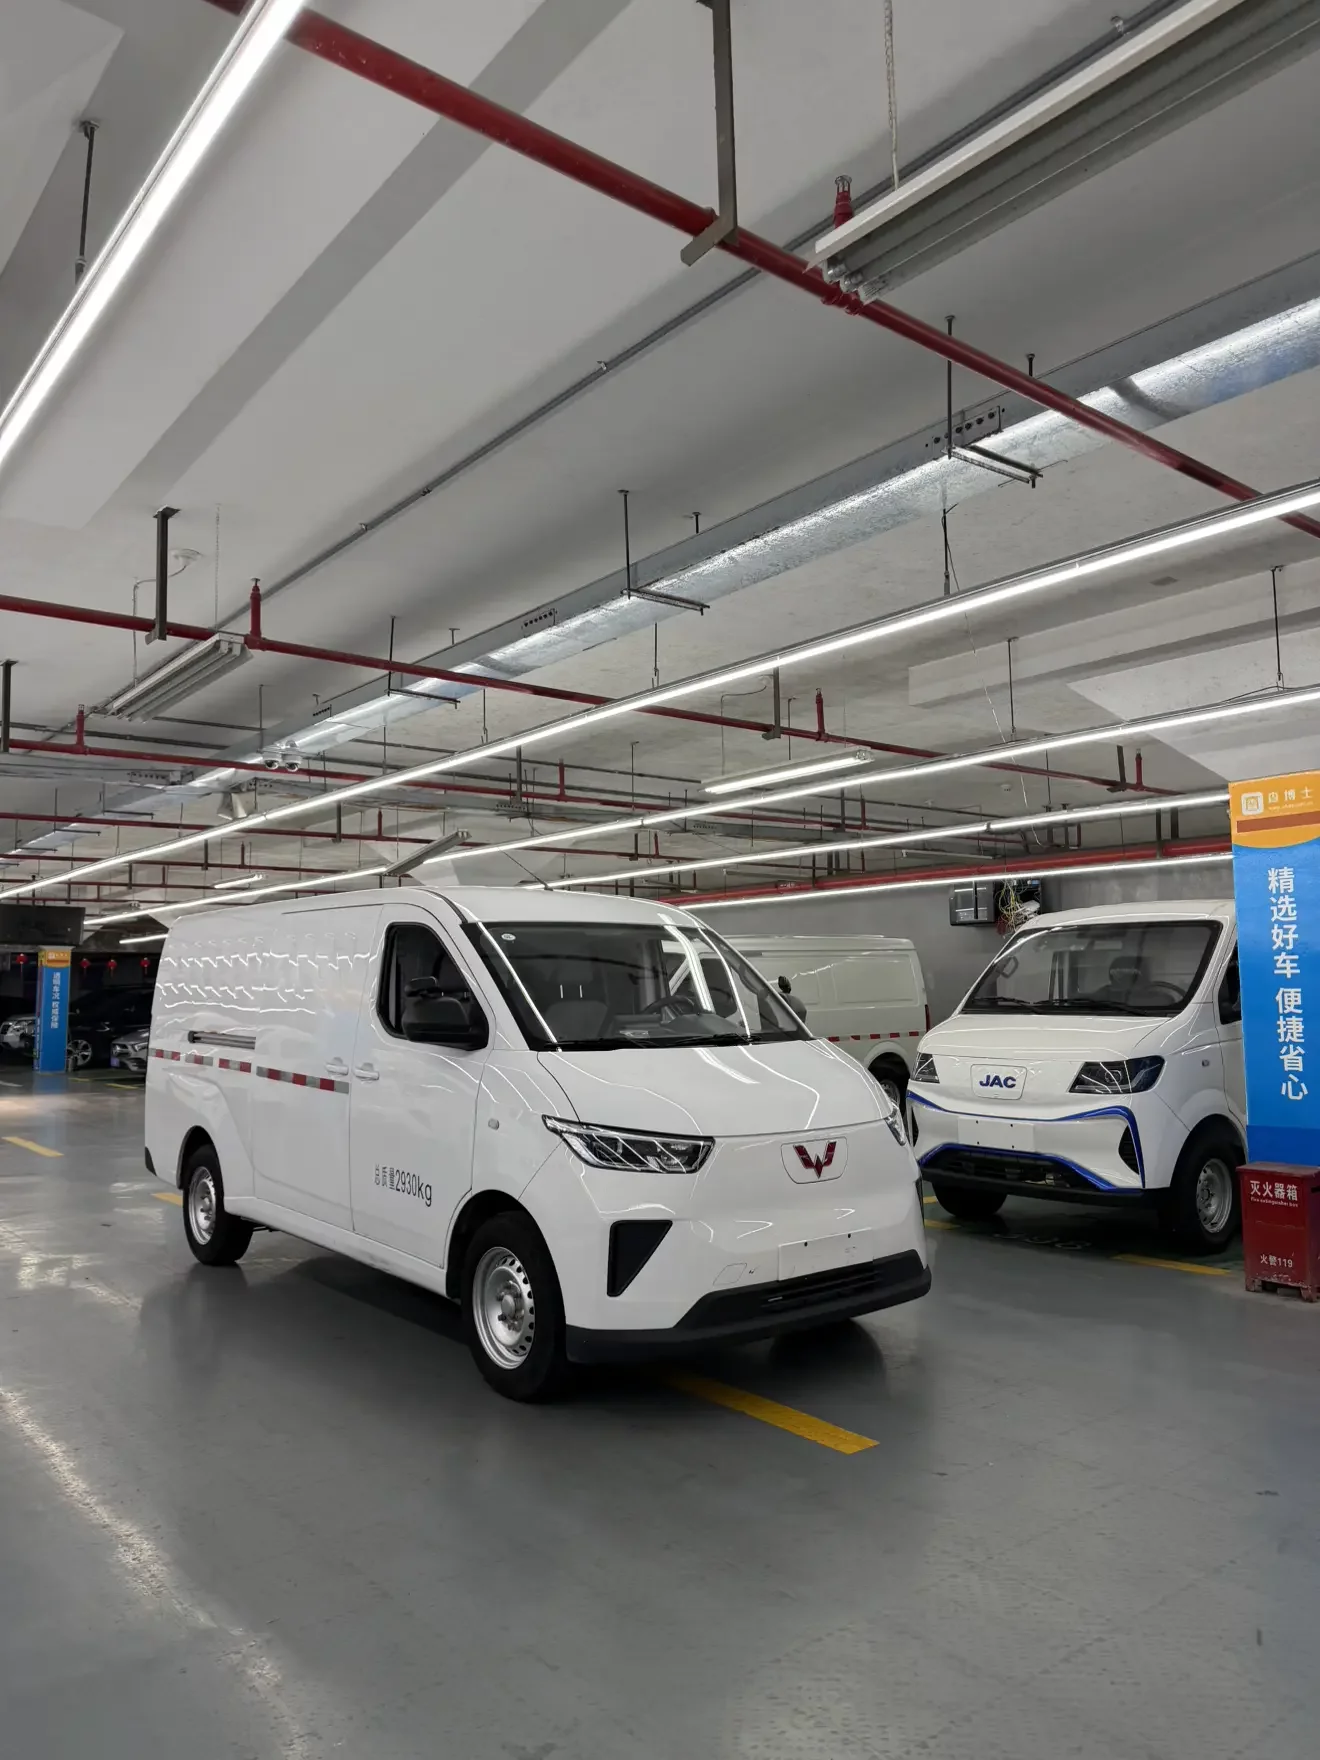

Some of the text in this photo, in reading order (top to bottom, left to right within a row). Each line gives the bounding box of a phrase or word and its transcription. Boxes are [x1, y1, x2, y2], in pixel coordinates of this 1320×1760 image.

[1268, 866, 1309, 1101] 精选好车 便捷省心
[979, 1074, 1017, 1089] JAC
[1250, 1180, 1298, 1202] 灭火器箱
[1260, 1253, 1293, 1268] 火警119
